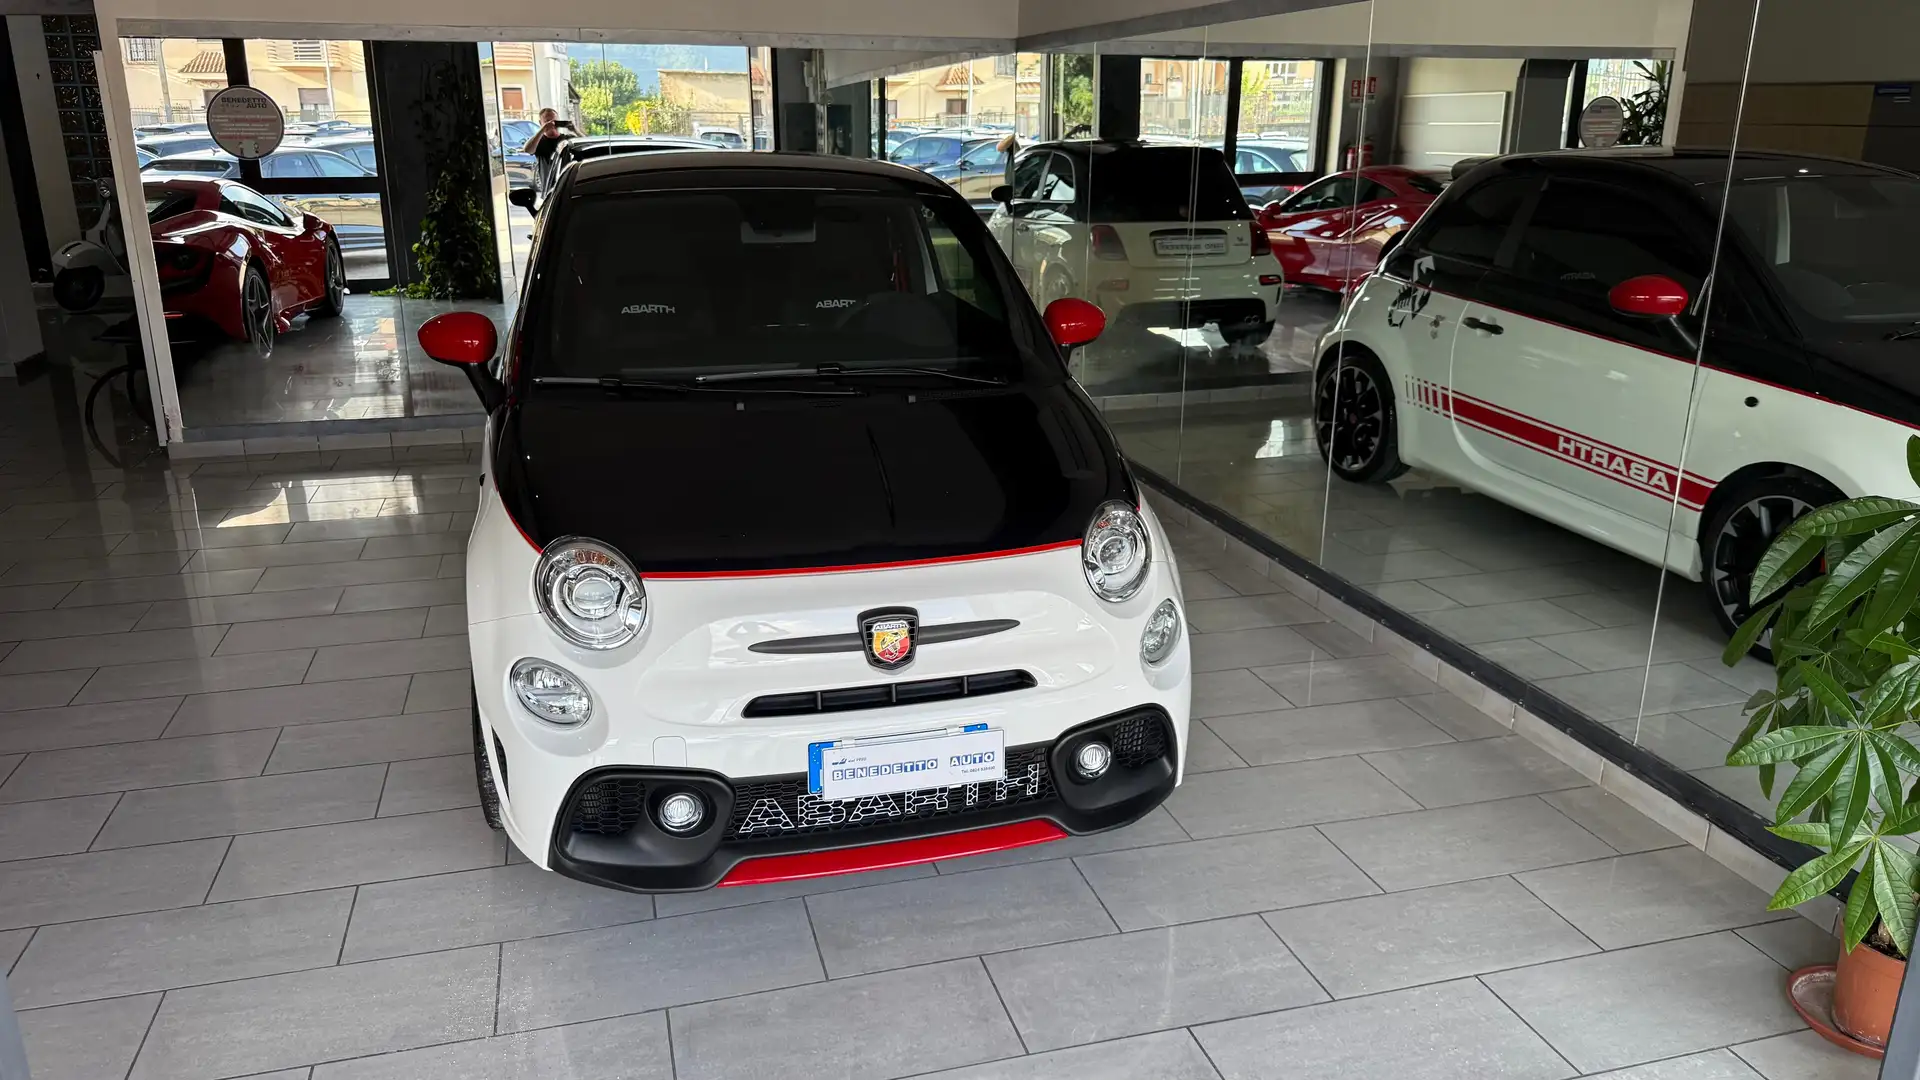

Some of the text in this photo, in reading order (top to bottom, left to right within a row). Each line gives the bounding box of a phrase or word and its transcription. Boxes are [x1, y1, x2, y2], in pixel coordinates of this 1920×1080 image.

[621, 304, 676, 314] ABARTH
[815, 299, 857, 309] ABART
[832, 751, 995, 781] BENEDETTO AUTO
